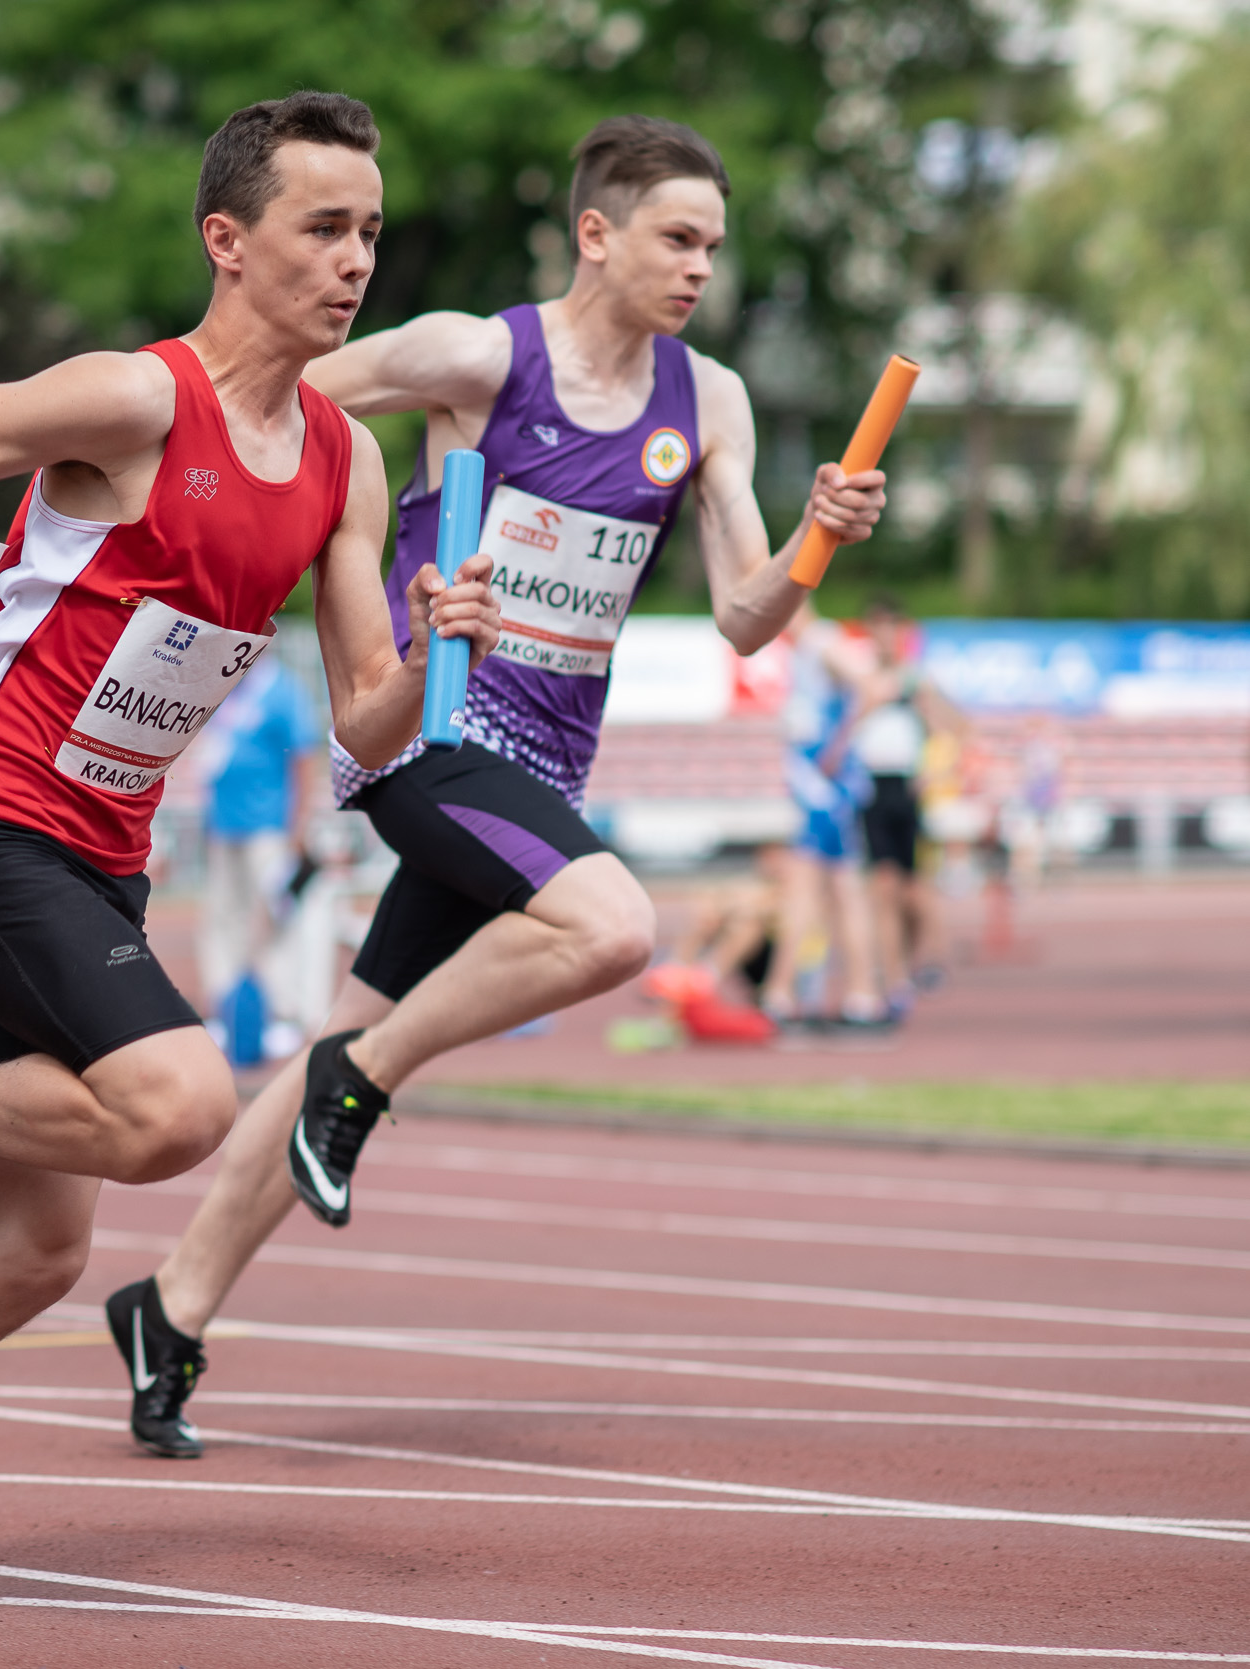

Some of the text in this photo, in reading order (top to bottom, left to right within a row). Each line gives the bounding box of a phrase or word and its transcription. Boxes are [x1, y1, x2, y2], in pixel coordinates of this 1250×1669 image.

[587, 526, 647, 565] 110
[491, 566, 628, 619] AŁKOWSKI
[152, 648, 184, 667] Kraków
[495, 639, 555, 665] AKÓW
[557, 653, 592, 671] 2019
[69, 733, 88, 746] PZLA
[88, 741, 132, 761] MISTRZOSTWA
[80, 760, 154, 790] KRAKÓW
